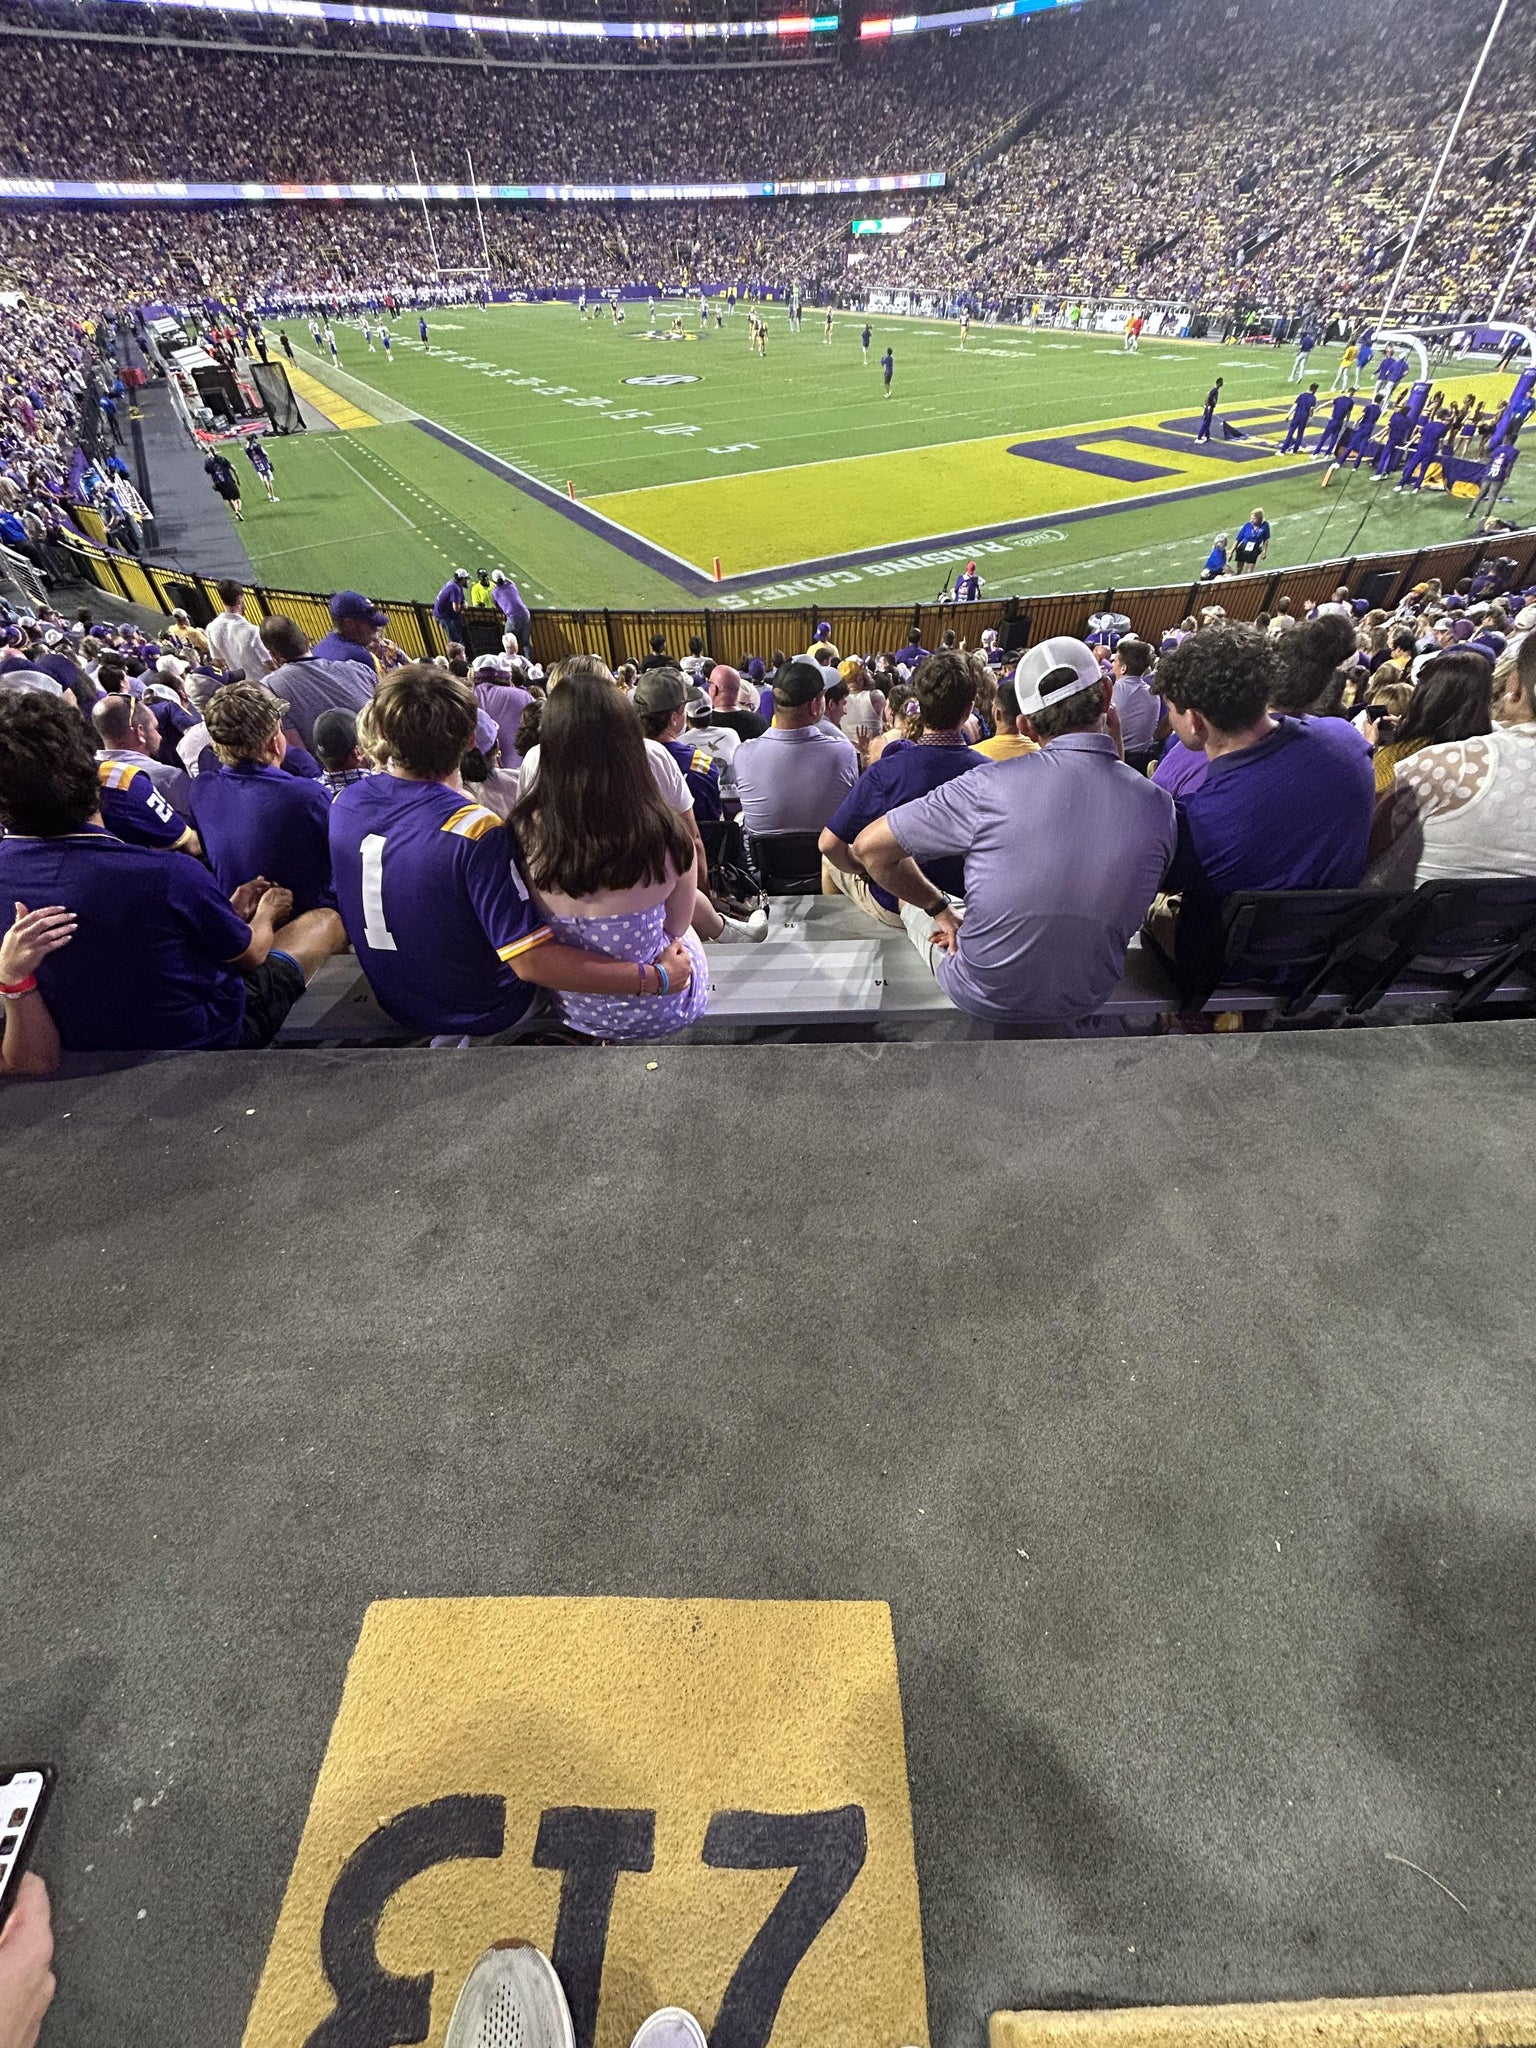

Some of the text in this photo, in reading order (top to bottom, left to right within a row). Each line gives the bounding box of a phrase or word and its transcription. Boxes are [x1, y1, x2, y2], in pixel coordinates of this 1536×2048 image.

[643, 422, 702, 435] 10
[706, 443, 760, 454] 5
[717, 541, 1013, 609] RAISING CANE'S
[359, 833, 398, 951] 1
[875, 979, 889, 987] 14
